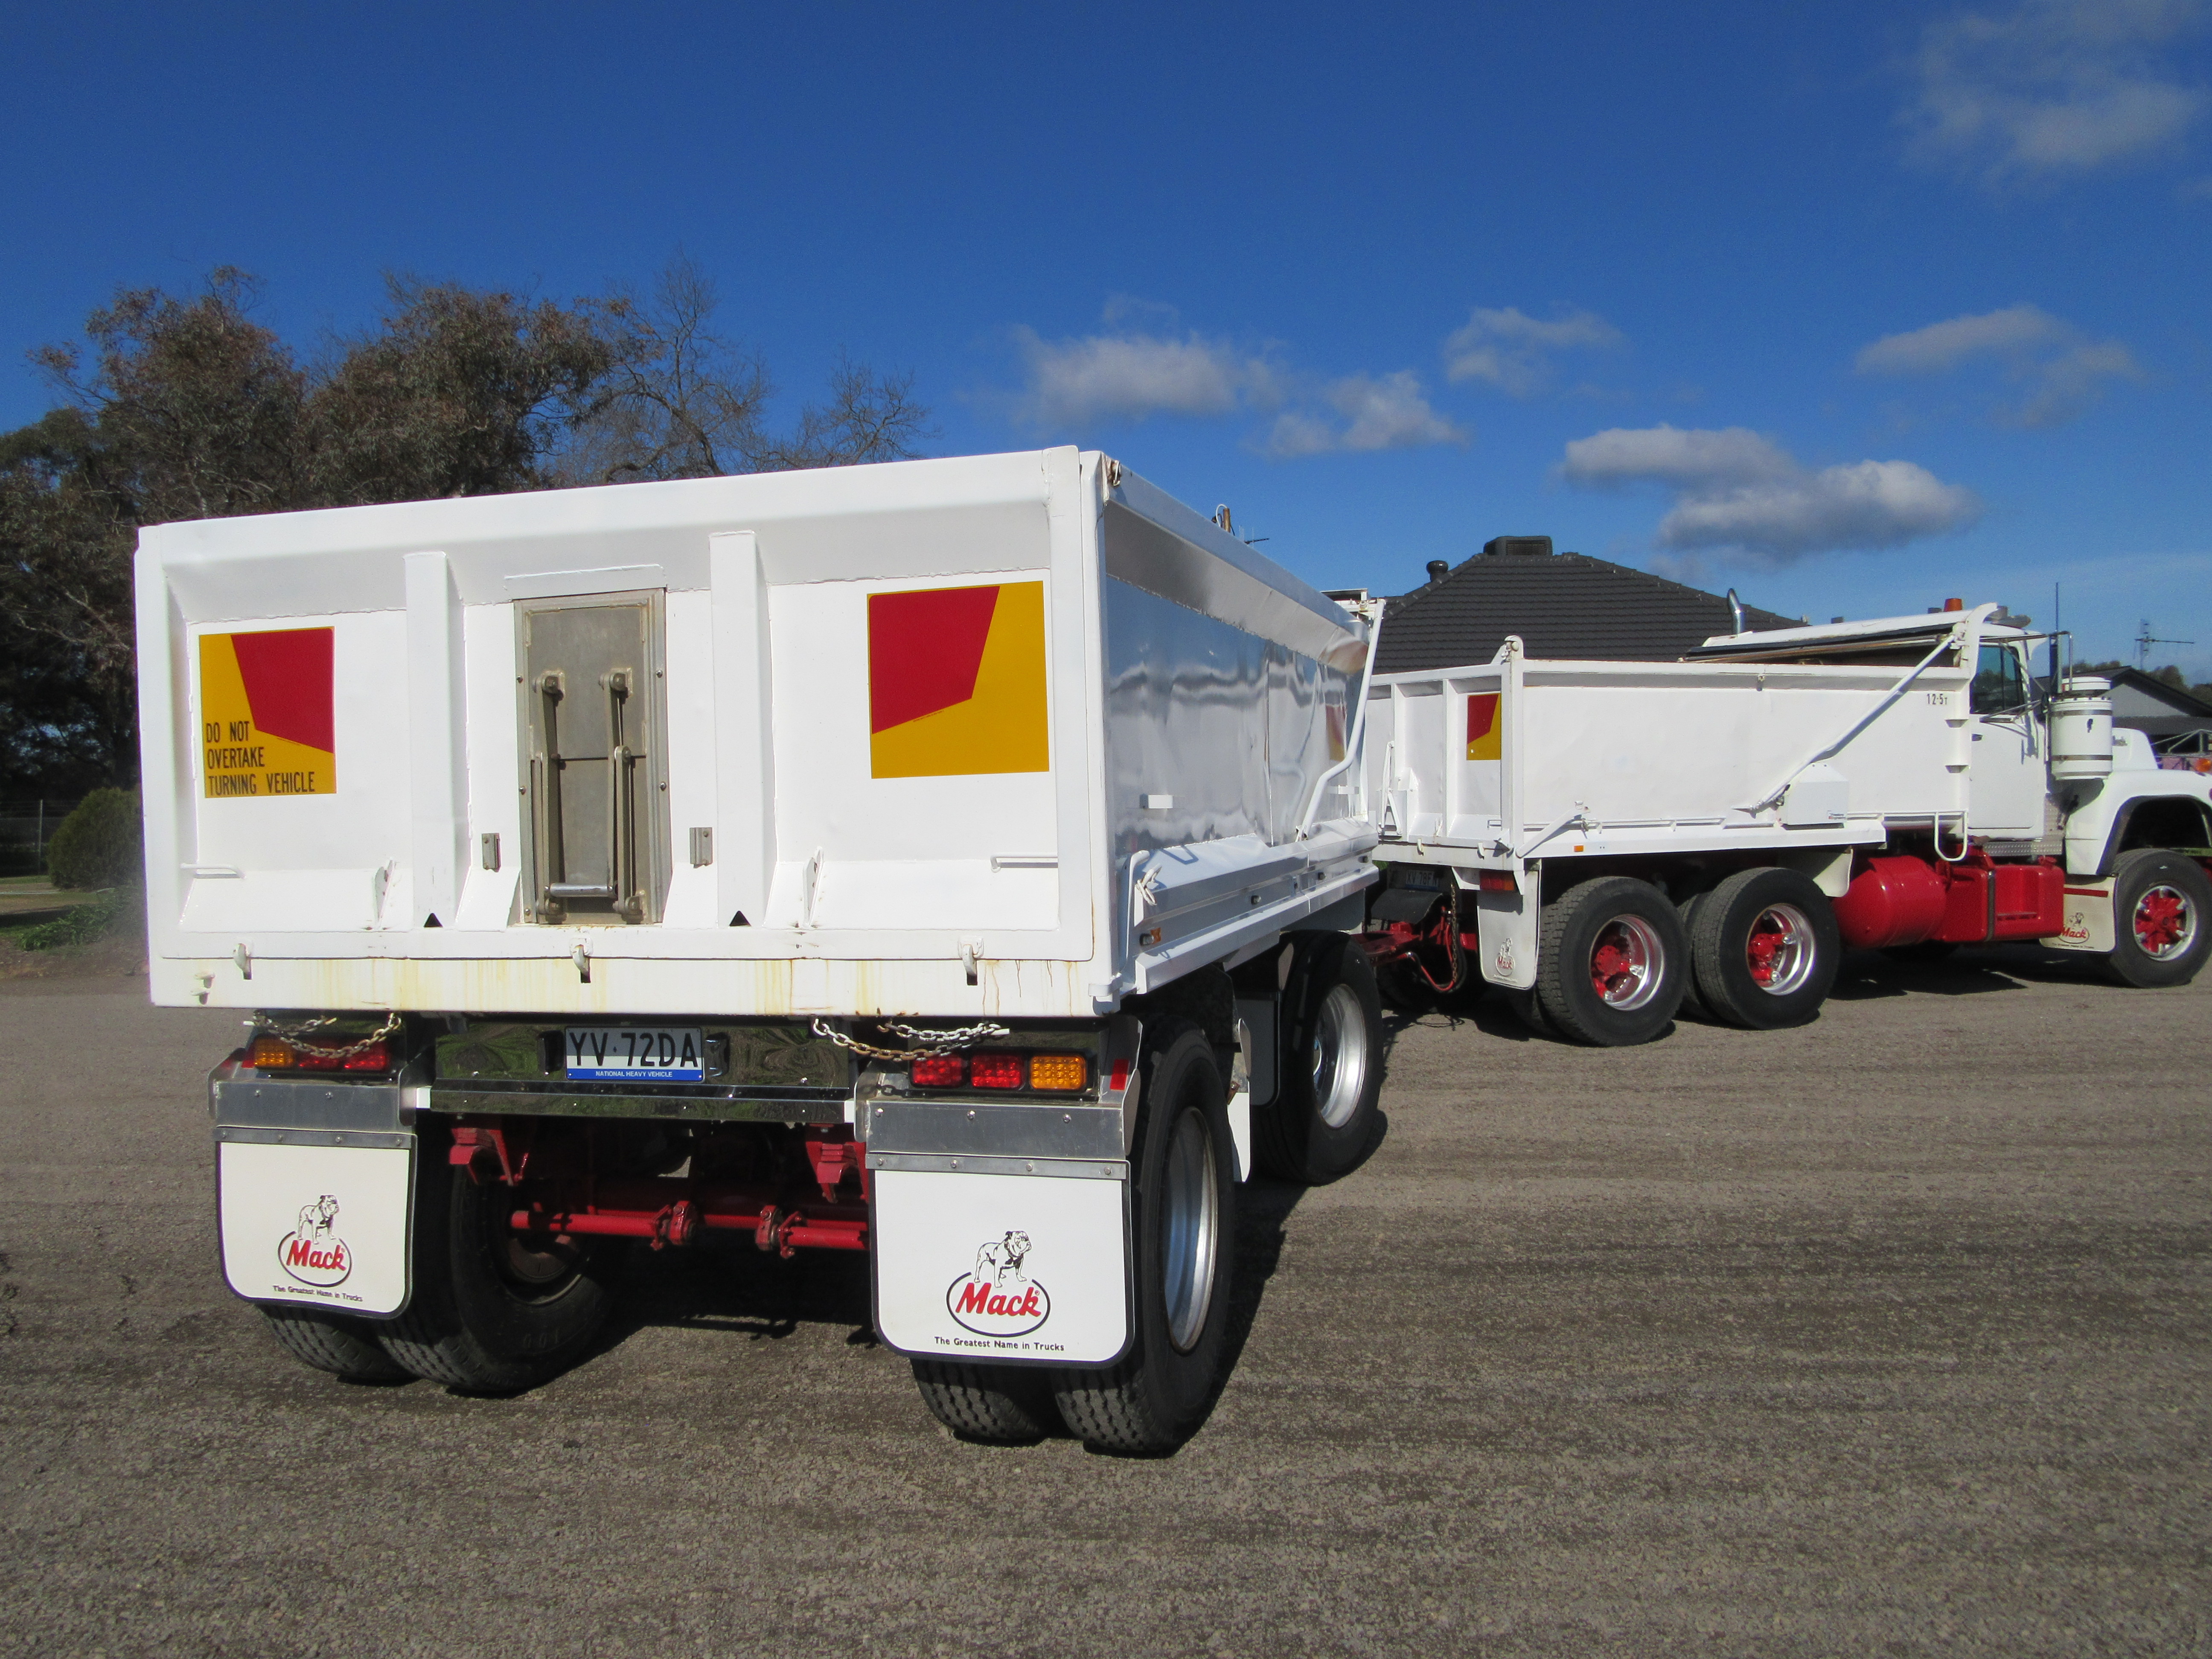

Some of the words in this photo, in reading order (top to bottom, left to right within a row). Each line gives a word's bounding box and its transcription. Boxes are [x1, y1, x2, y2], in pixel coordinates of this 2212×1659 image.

[206, 722, 220, 743] DO
[230, 721, 250, 742] NOT
[207, 747, 265, 769] OVERTAKE
[208, 773, 256, 795] TURNING
[266, 771, 315, 793] VEHICLE
[286, 1239, 346, 1271] Mack
[288, 1286, 314, 1295] Greatest
[316, 1289, 333, 1298] Name
[342, 1292, 363, 1301] Trucks
[955, 1282, 1042, 1317] Mack
[934, 1336, 950, 1345] The
[954, 1337, 991, 1348] Greatest
[994, 1340, 1019, 1349] Name
[1022, 1341, 1030, 1350] in
[1033, 1342, 1065, 1351] Trucks
